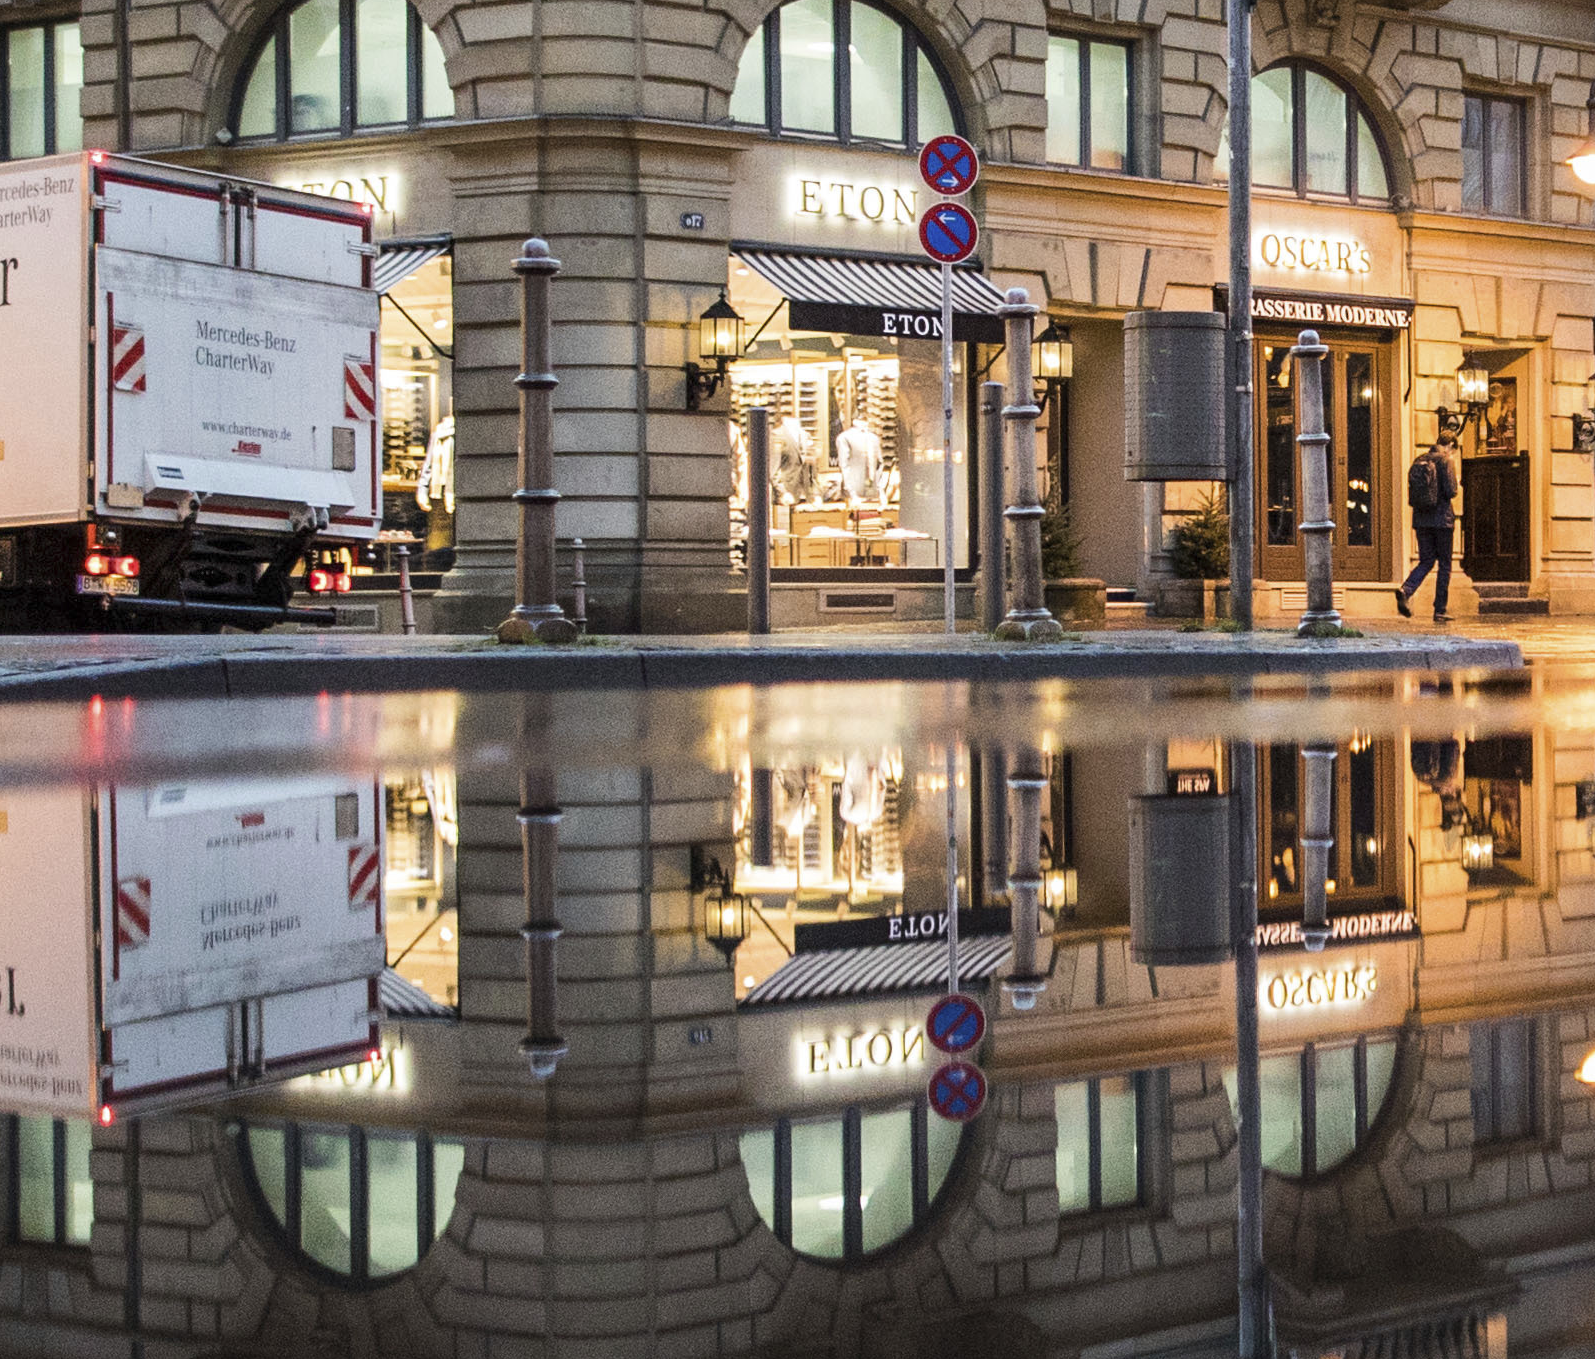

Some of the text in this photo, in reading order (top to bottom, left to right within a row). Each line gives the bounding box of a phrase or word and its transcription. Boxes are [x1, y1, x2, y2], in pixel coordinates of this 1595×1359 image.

[798, 179, 919, 223] ETON
[883, 313, 943, 337] ETON
[1251, 299, 1410, 328] RASSERIE MODERNE
[195, 319, 297, 354] Mercedes-Benz
[195, 346, 275, 379] CharterWay
[202, 420, 292, 441] www.charterway.de
